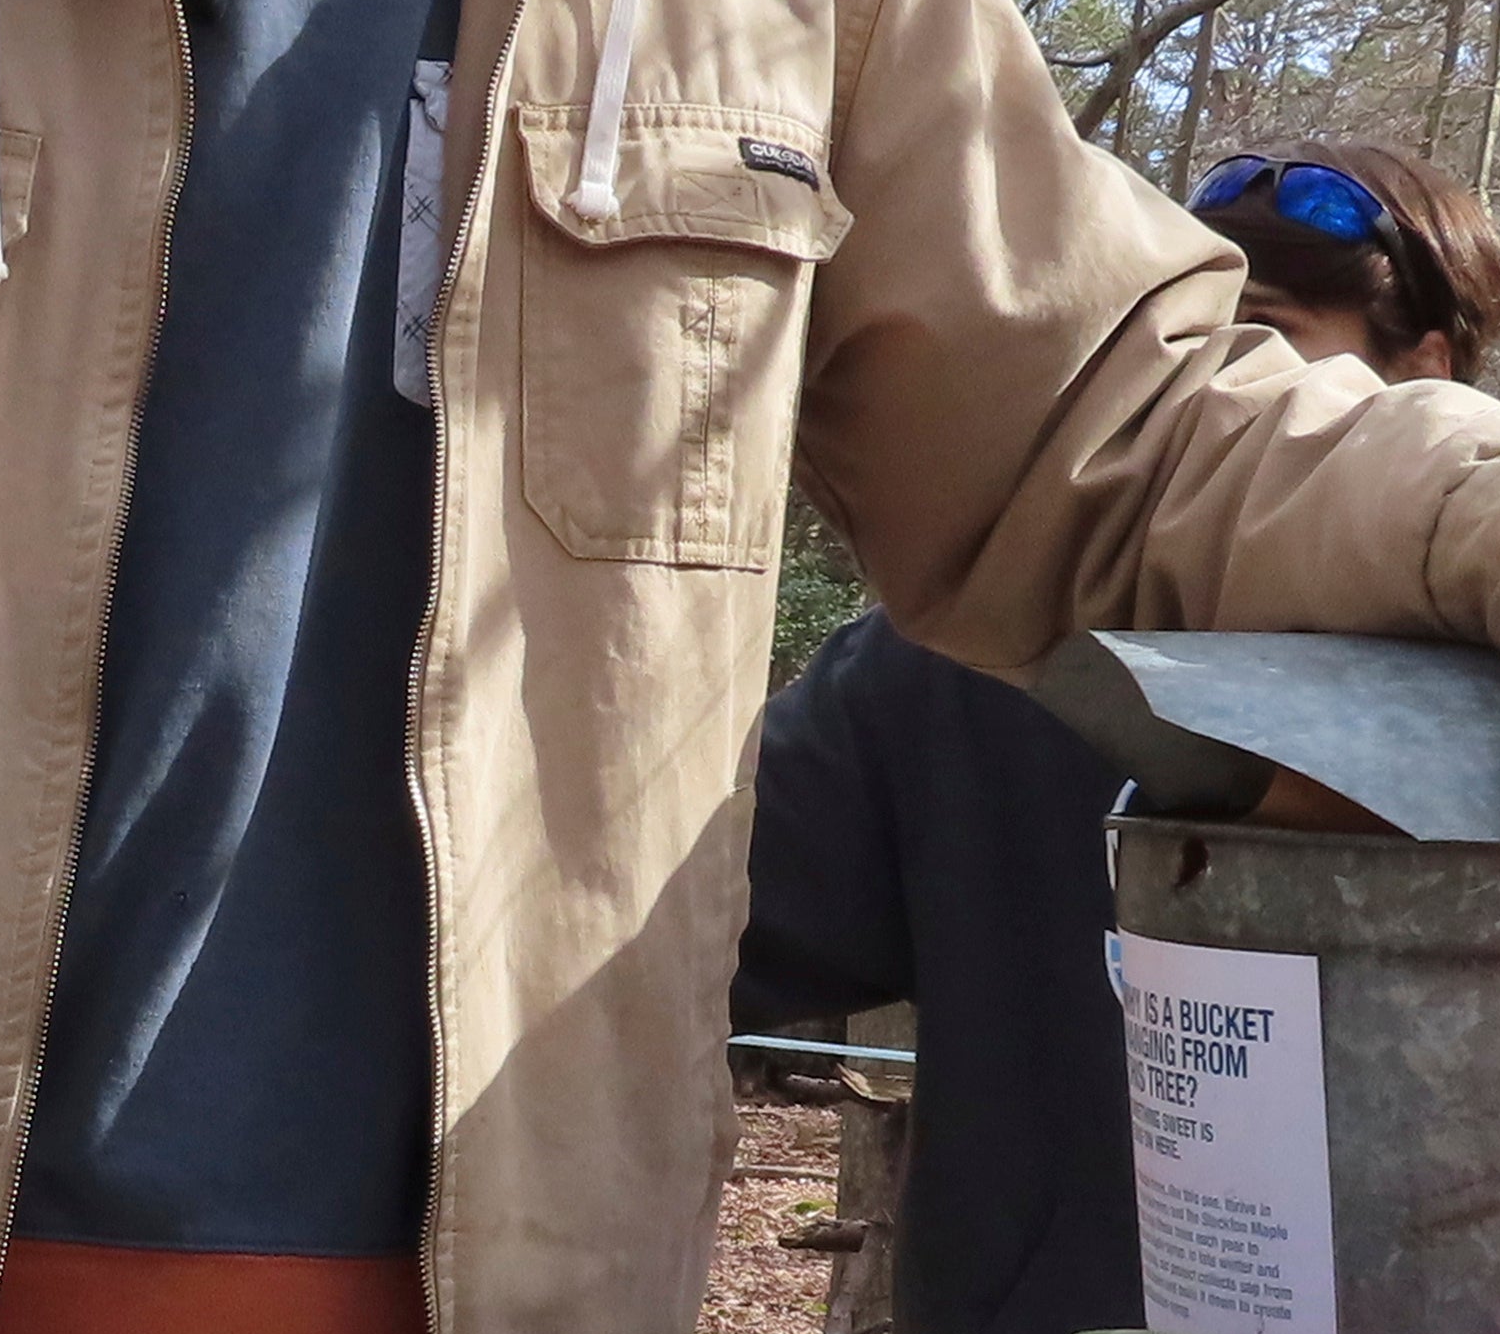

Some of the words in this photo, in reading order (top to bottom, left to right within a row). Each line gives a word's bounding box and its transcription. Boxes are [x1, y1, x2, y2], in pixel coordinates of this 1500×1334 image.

[1145, 990, 1159, 1025] IS
[1162, 996, 1175, 1029] A
[1179, 999, 1275, 1043] BUCKET
[1126, 1016, 1176, 1066] NGING
[1181, 1036, 1248, 1079] FROM
[1146, 1064, 1198, 1108] TREE?
[1162, 1113, 1198, 1140] SWEET
[1201, 1122, 1214, 1143] IS
[1225, 1196, 1256, 1216] thrive
[1260, 1203, 1271, 1217] in
[1201, 1212, 1248, 1234] Stockton
[1250, 1221, 1288, 1241] Maple
[1248, 1242, 1259, 1256] to
[1257, 1264, 1280, 1279] and
[1240, 1281, 1260, 1298] sap
[1264, 1283, 1293, 1301] from
[1239, 1298, 1250, 1313] to
[1253, 1304, 1292, 1320] create
